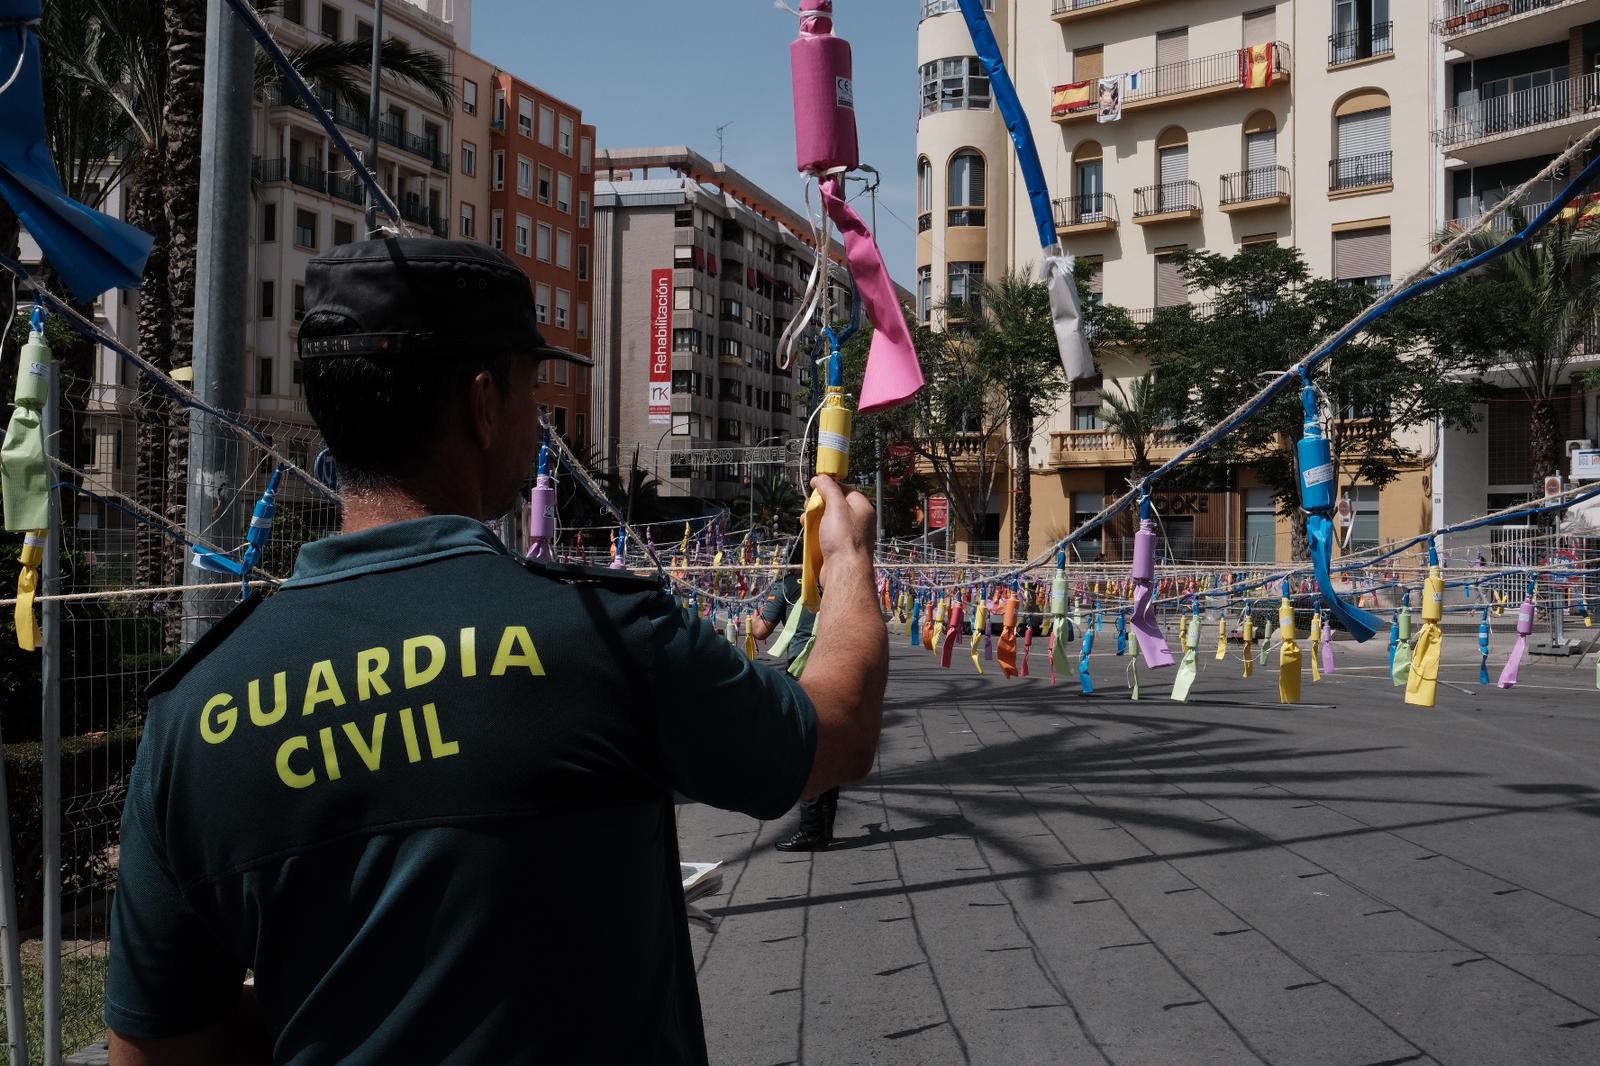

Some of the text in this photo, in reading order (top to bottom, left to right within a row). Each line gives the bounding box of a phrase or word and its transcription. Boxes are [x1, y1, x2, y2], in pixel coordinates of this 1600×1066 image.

[654, 277, 669, 374] Rehabilitación
[744, 447, 786, 463] RENFE
[199, 626, 546, 745] GUARDIA
[275, 702, 460, 789] CIVIL
